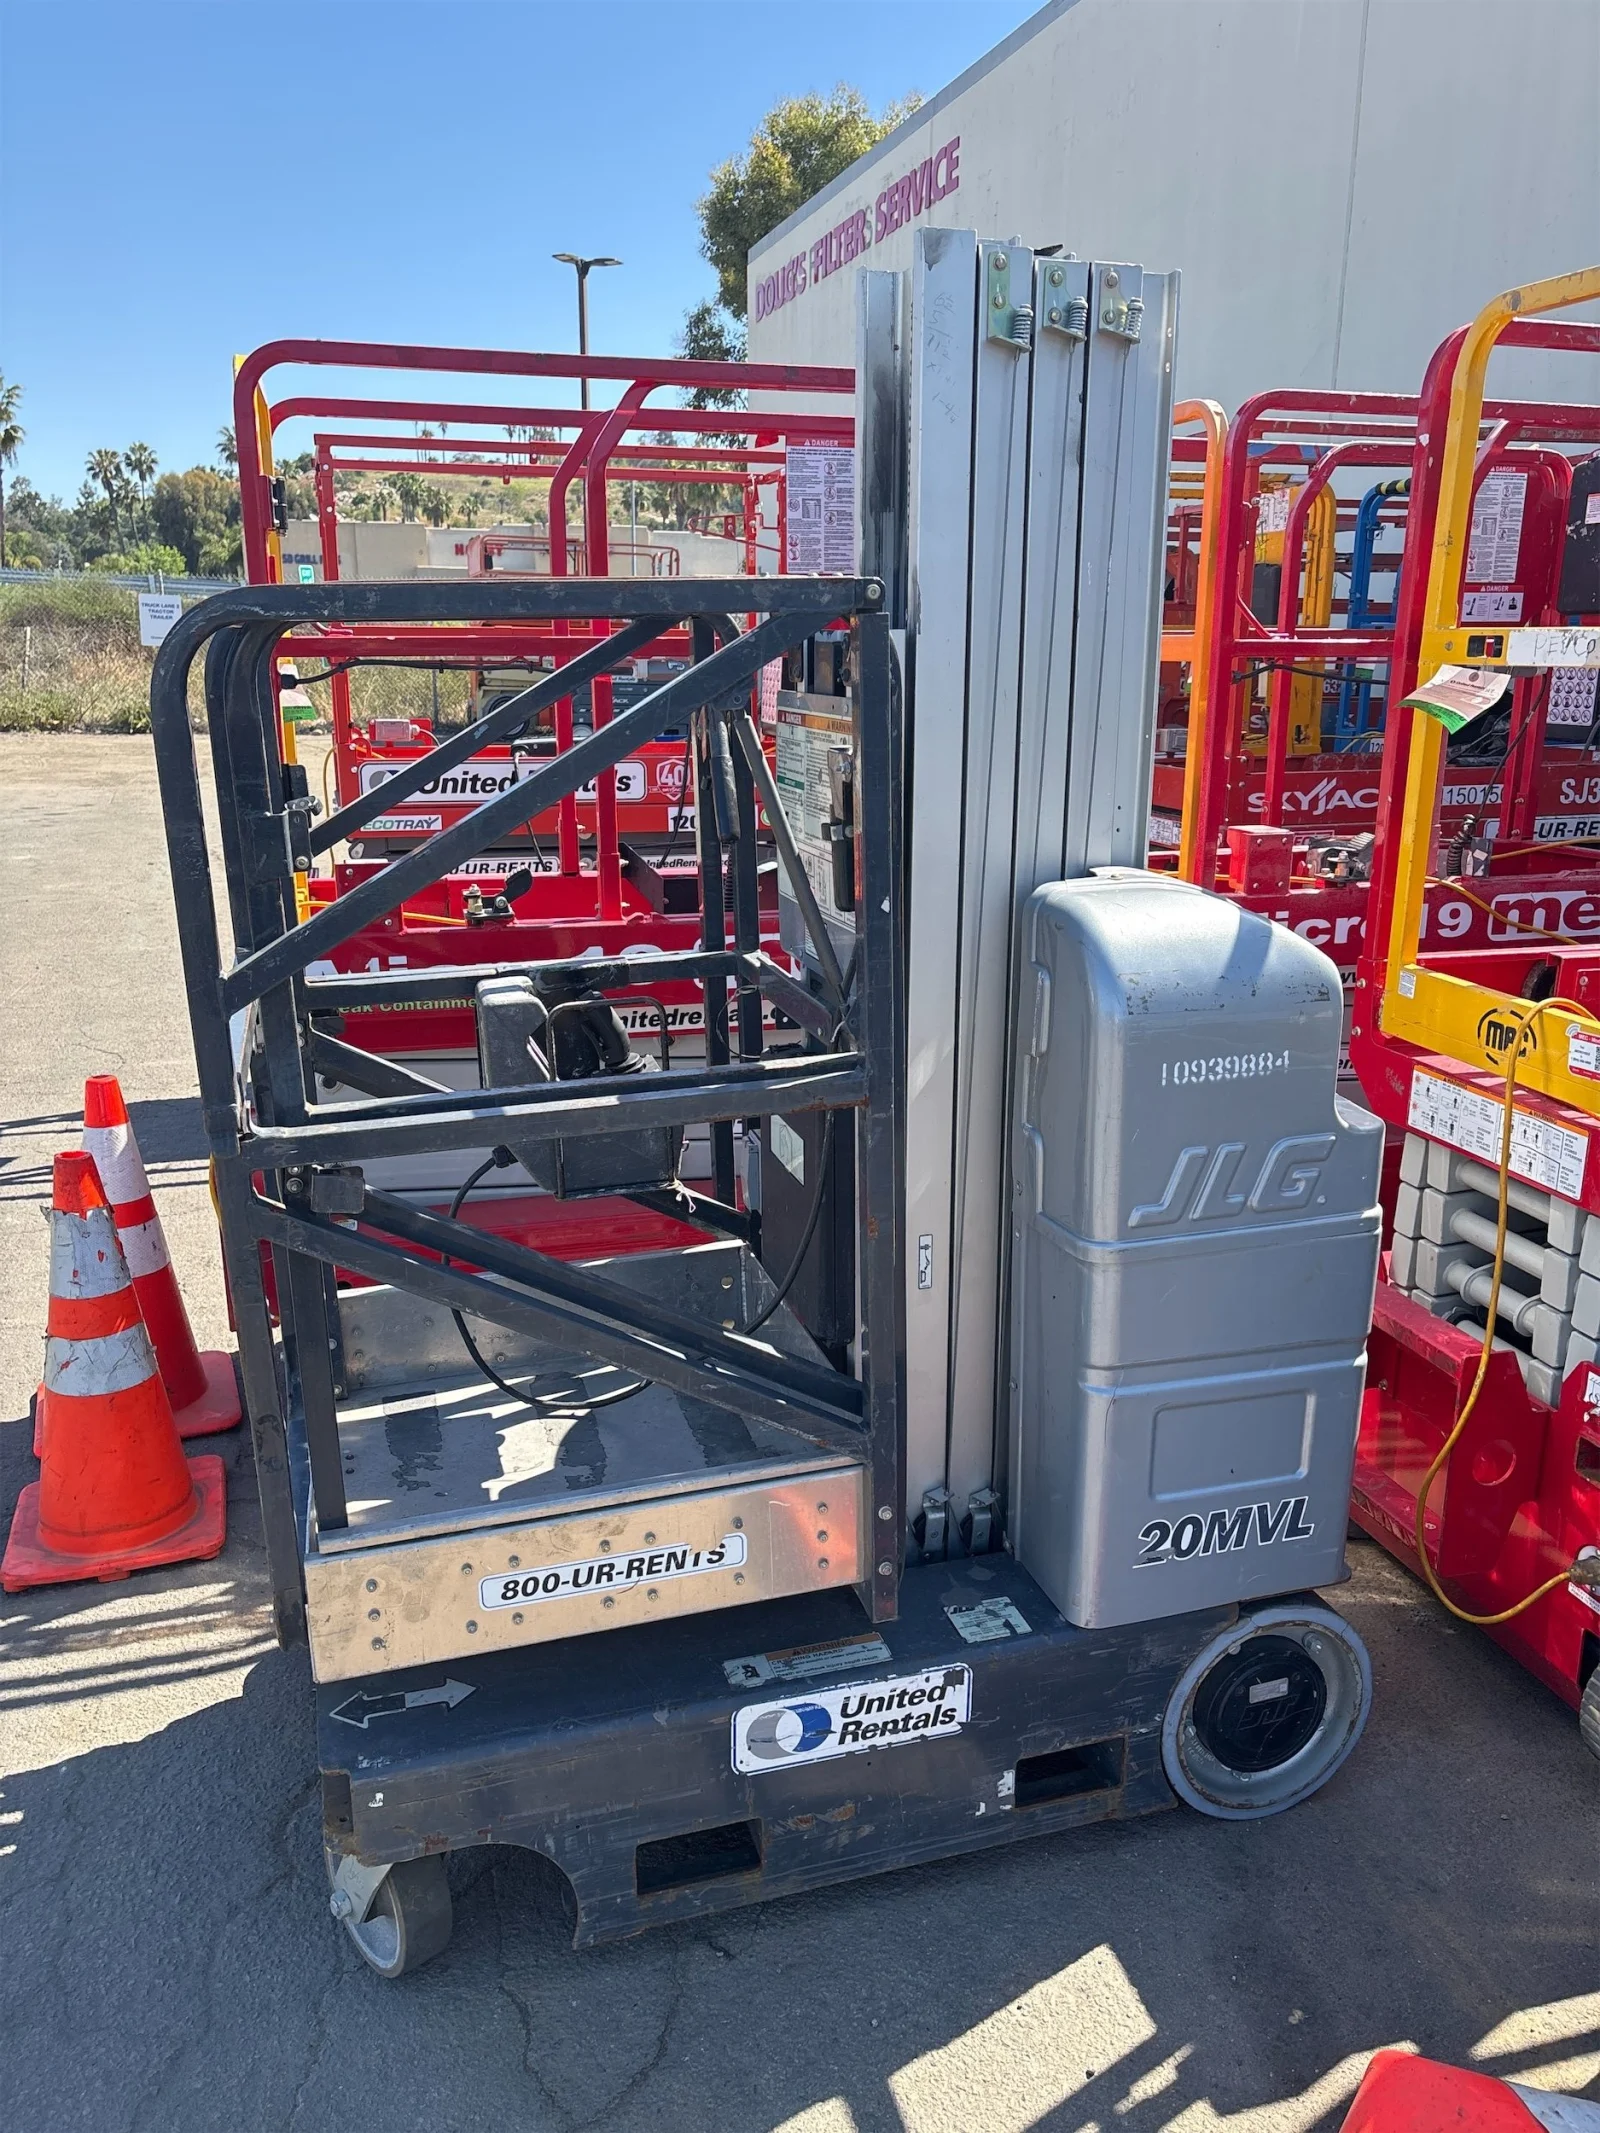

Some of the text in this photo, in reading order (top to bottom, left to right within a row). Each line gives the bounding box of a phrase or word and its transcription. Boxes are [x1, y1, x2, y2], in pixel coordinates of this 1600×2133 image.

[875, 136, 960, 244] SERVICE
[811, 439, 839, 447] DANGER
[660, 764, 687, 787] 40
[362, 817, 440, 830] ECOTRAY
[1161, 1050, 1290, 1086] 10939884
[1133, 1496, 1315, 1569] 20MVL
[500, 1542, 727, 1601] 800-UR-RENTS
[840, 1684, 947, 1719] United
[838, 1705, 957, 1746] Rentals
